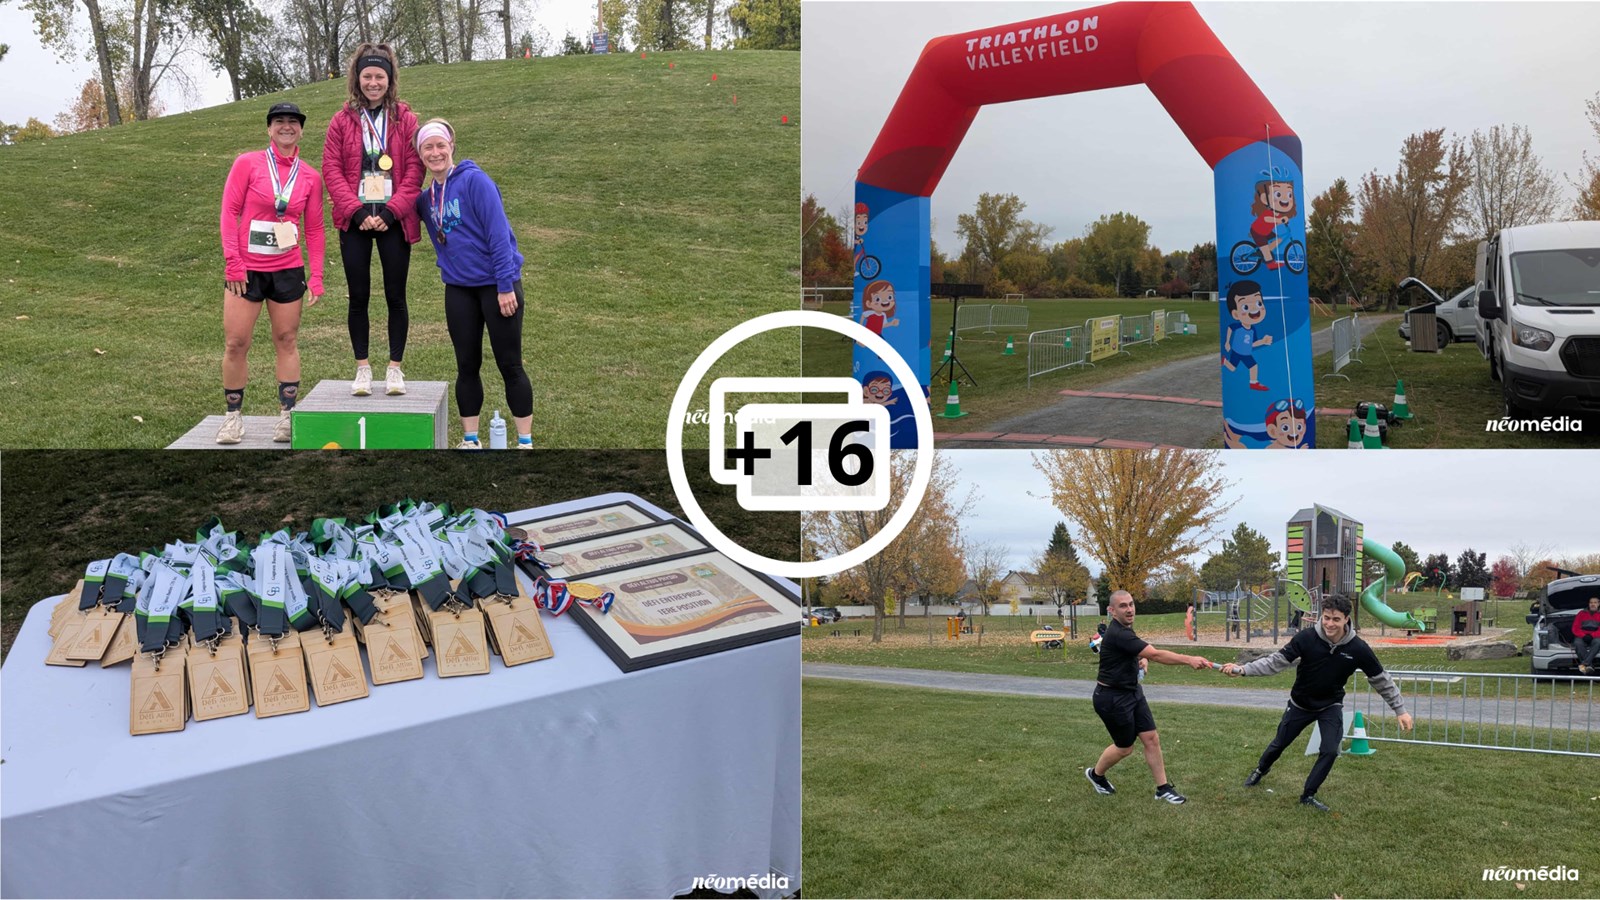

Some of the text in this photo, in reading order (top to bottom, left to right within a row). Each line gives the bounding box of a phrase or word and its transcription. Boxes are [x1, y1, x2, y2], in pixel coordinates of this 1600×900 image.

[966, 16, 1099, 52] TRIATHLON
[966, 35, 1099, 71] VALLEYFIELD
[357, 416, 366, 449] 1
[642, 589, 706, 608] DÉFI ENTREPRISE
[677, 599, 713, 612] POSITION
